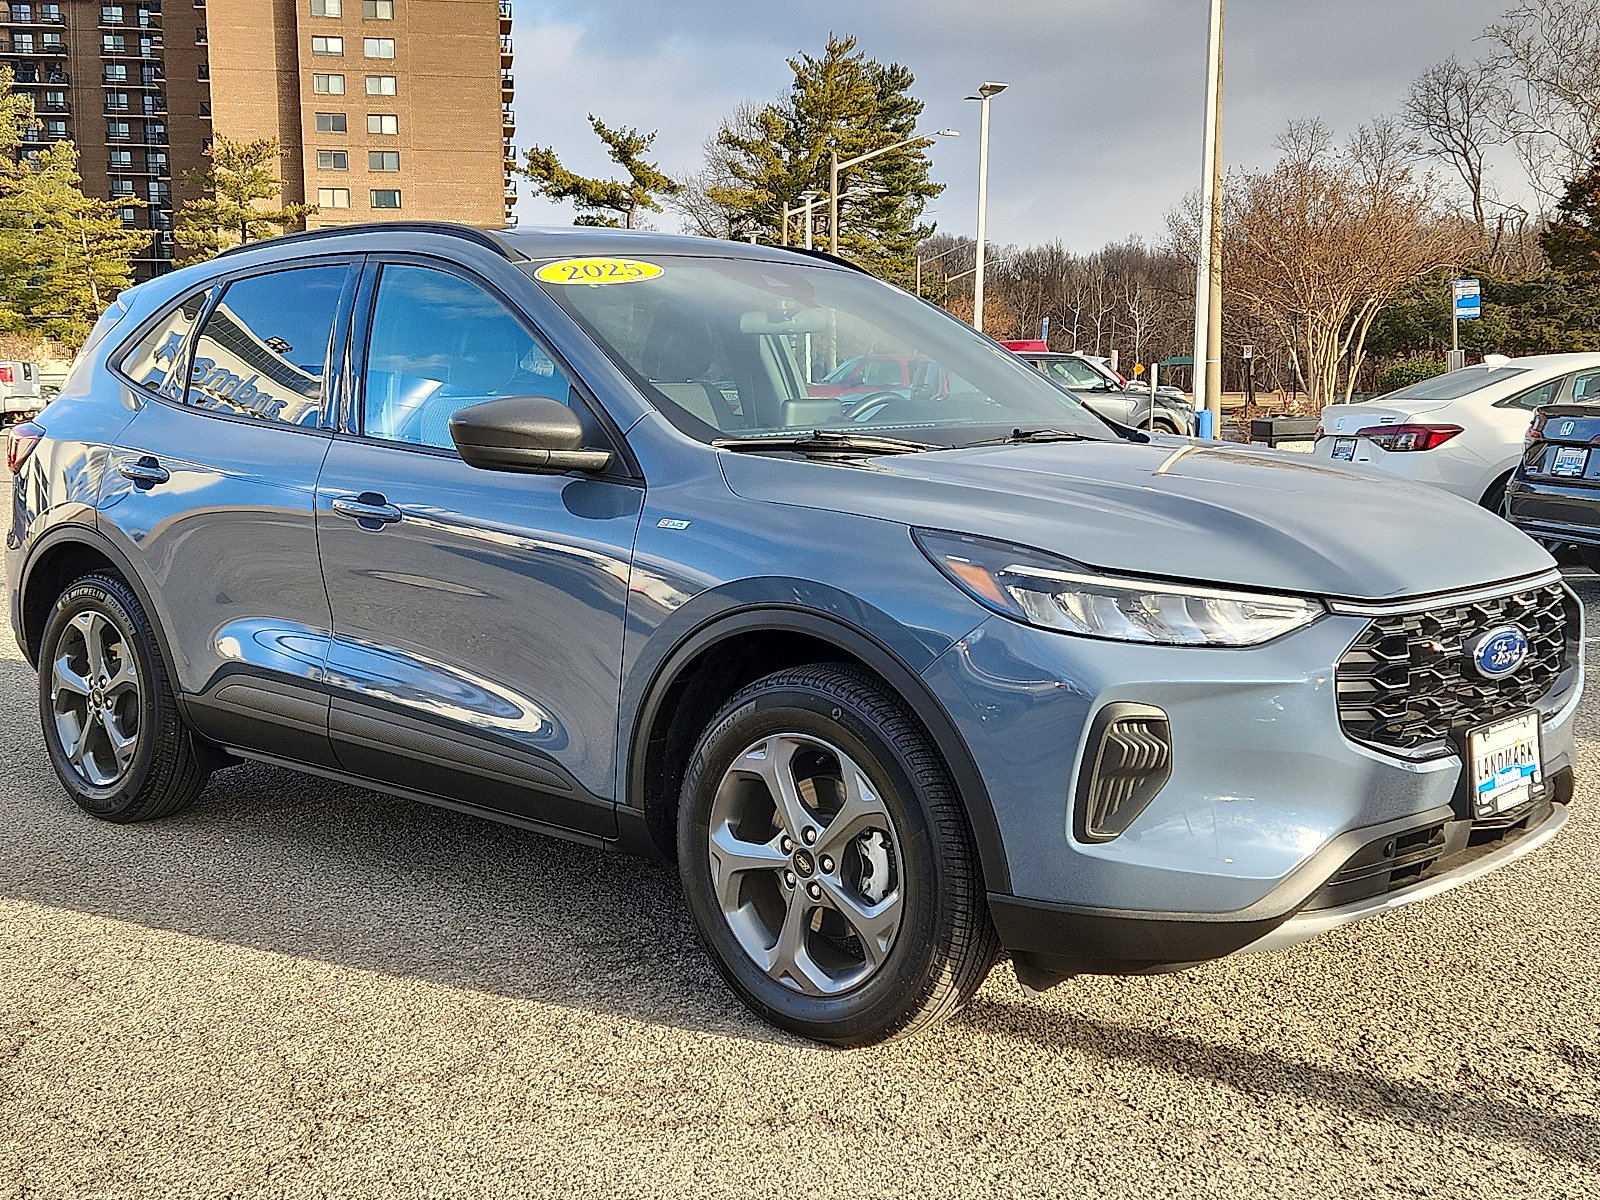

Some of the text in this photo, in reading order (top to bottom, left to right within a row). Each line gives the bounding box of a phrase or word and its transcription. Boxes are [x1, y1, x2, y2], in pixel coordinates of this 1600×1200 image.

[562, 263, 643, 281] 2025
[71, 588, 105, 600] MICHELIN
[1491, 638, 1520, 668] Ford
[706, 714, 737, 750] PRIMACY
[1477, 740, 1534, 780] LANDMARK
